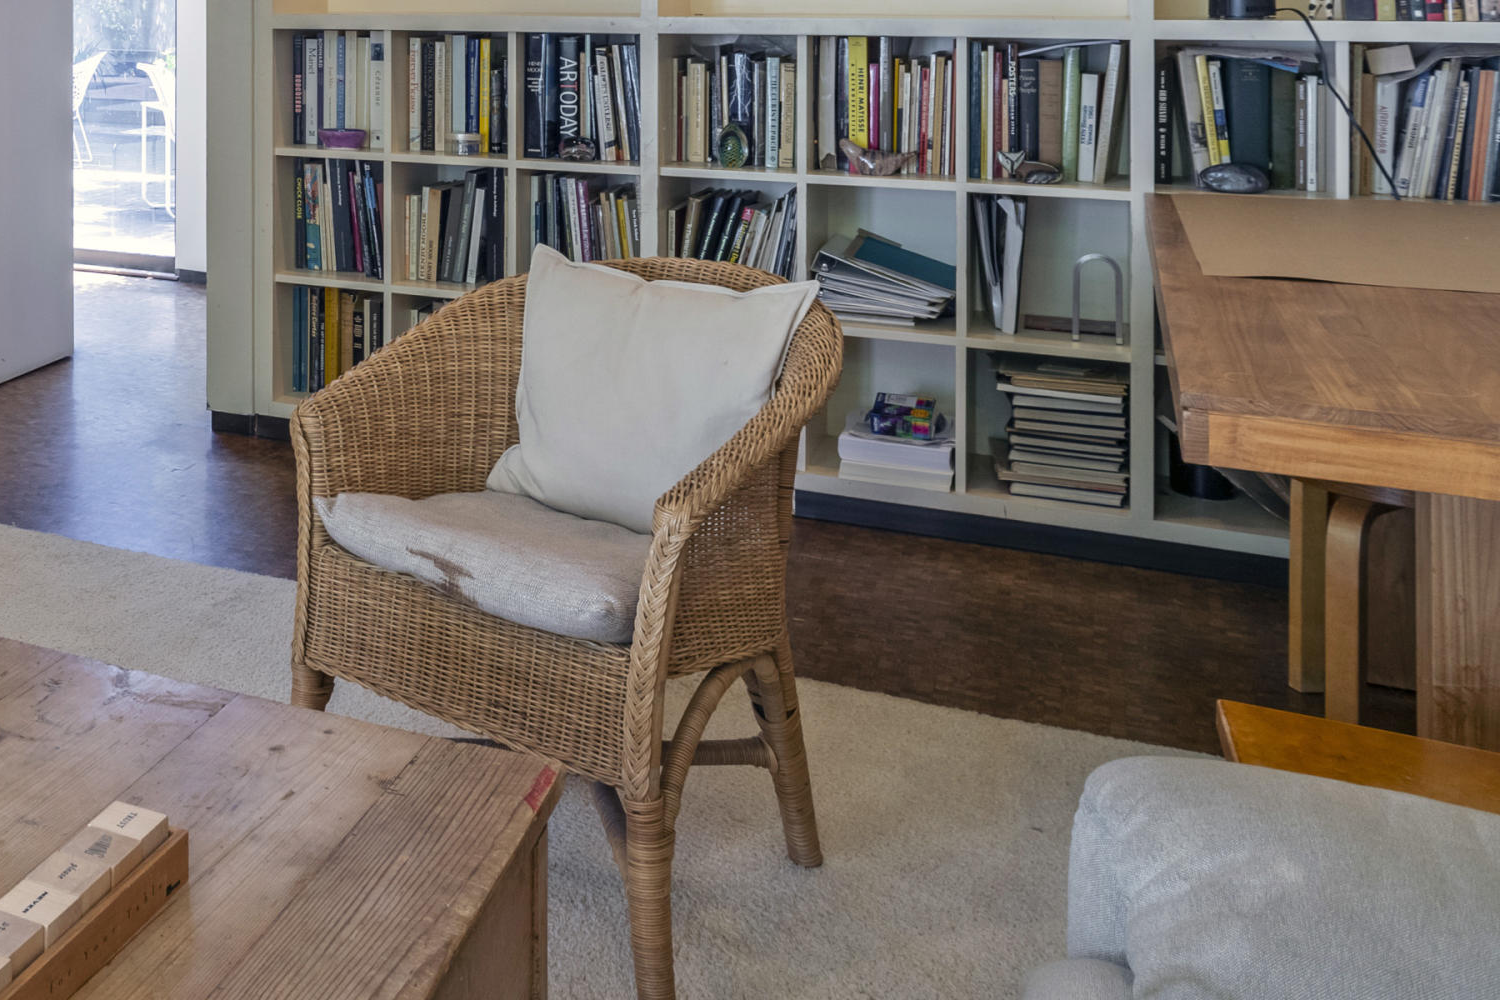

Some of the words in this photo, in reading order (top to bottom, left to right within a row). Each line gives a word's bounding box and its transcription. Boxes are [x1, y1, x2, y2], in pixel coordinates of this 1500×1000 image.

[307, 48, 316, 75] Manet
[1008, 61, 1016, 96] POSTERS
[559, 56, 578, 137] ARTODAY
